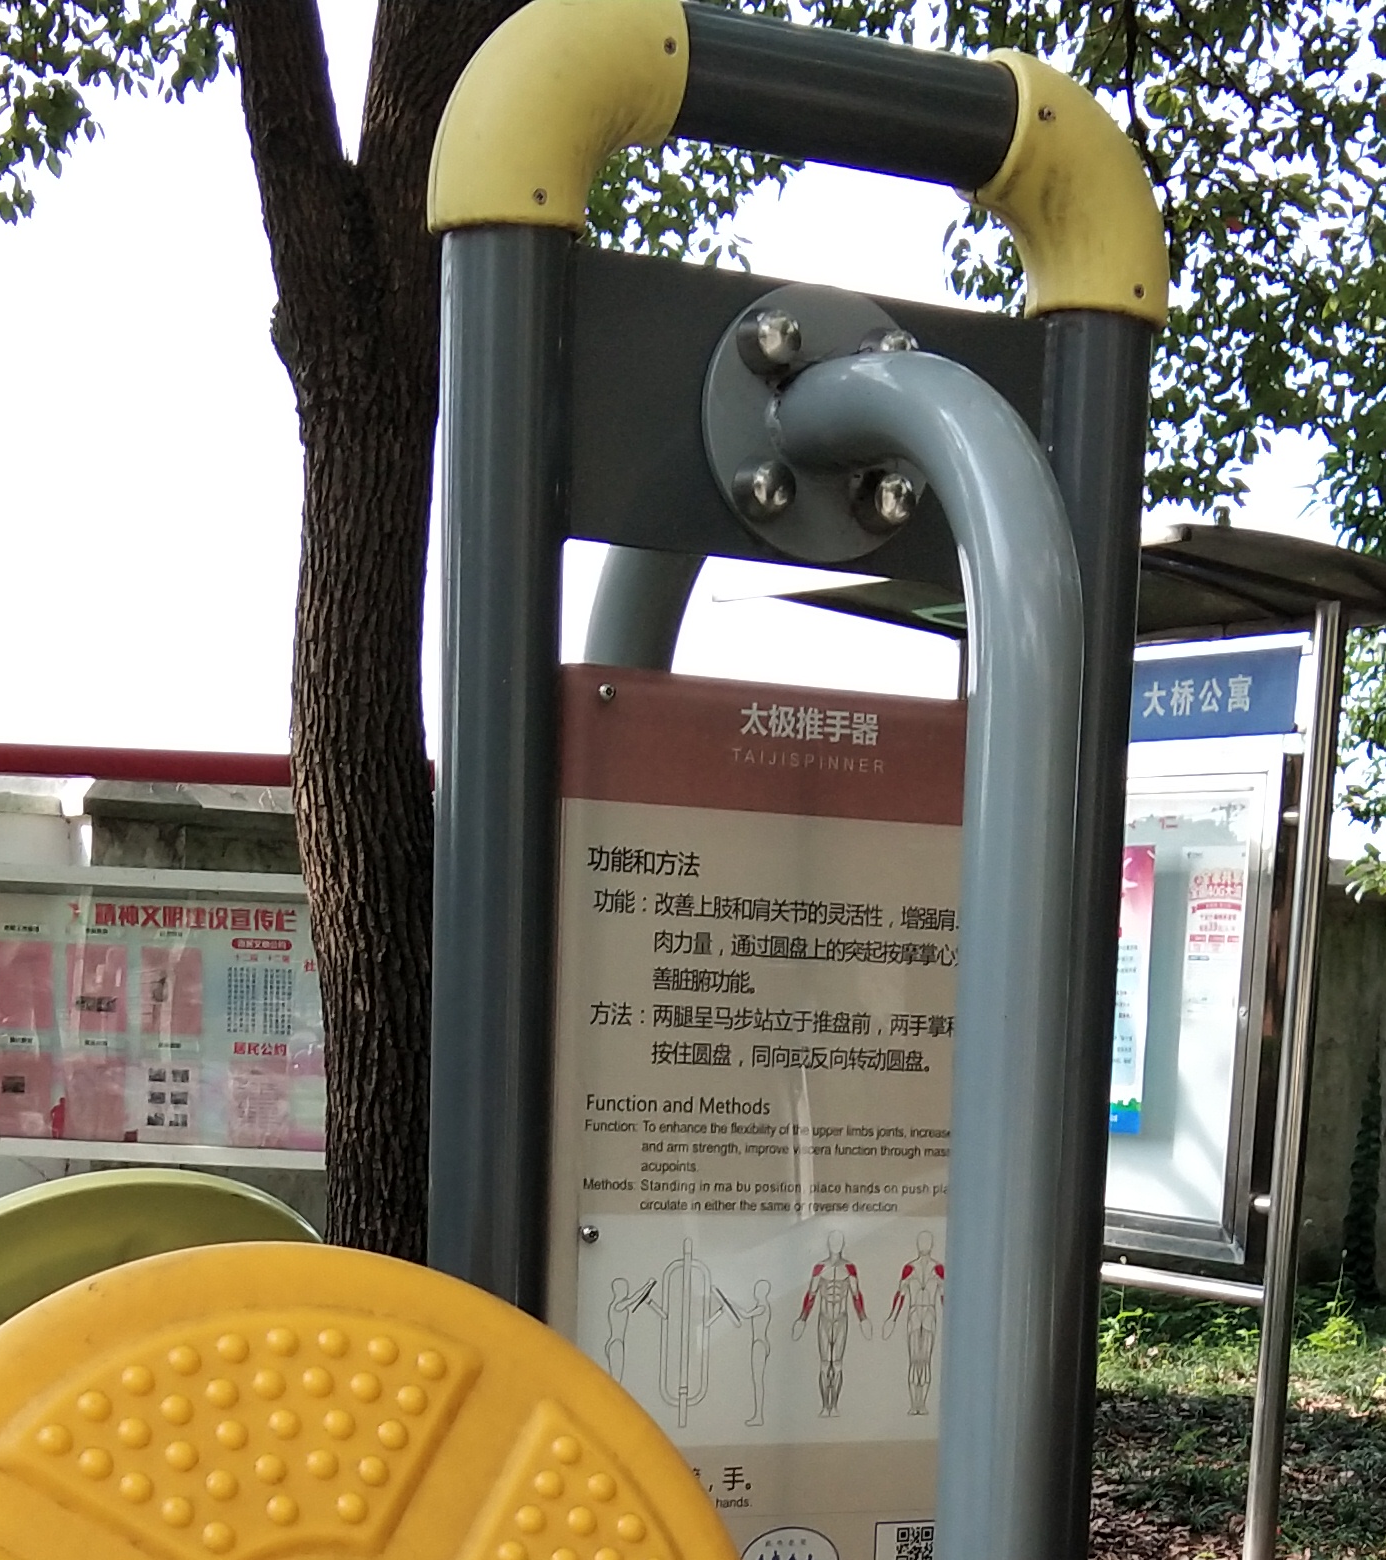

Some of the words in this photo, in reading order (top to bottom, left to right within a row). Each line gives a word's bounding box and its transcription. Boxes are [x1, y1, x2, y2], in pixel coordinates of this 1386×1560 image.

[1142, 673, 1253, 719] 大桥公寓
[740, 702, 879, 746] 太极推手器
[587, 845, 701, 878] 功能和方法
[95, 903, 297, 933] 精神文明建设宣传栏
[653, 930, 959, 967] 肉力量，通过圆盘上的突起按摩掌心
[652, 966, 756, 994] 善脏腑功能。
[651, 1041, 930, 1073] 按住圆盘，同向或反向转动圆盘。
[586, 1094, 658, 1113] Function
[663, 1096, 694, 1114] and
[699, 1096, 771, 1115] Methods
[643, 1120, 656, 1132] To
[659, 1121, 707, 1134] enhance
[710, 1121, 728, 1134] the
[779, 1123, 791, 1135] of
[813, 1127, 844, 1139] upper
[846, 1125, 875, 1138] limbs
[641, 1141, 664, 1153] and
[666, 1143, 689, 1154] arm
[834, 1144, 877, 1157] function
[880, 1146, 921, 1160] through
[640, 1179, 695, 1195] Standing
[699, 1182, 711, 1192] in
[714, 1184, 733, 1193] ma
[736, 1181, 751, 1193] bu
[845, 1184, 881, 1196] hands
[884, 1186, 898, 1195] on
[901, 1187, 930, 1198] push
[639, 1200, 688, 1212] circulate
[691, 1200, 701, 1212] in
[704, 1201, 737, 1212] either
[739, 1200, 757, 1212] the
[760, 1204, 791, 1213] same
[716, 1496, 753, 1509] hands.
